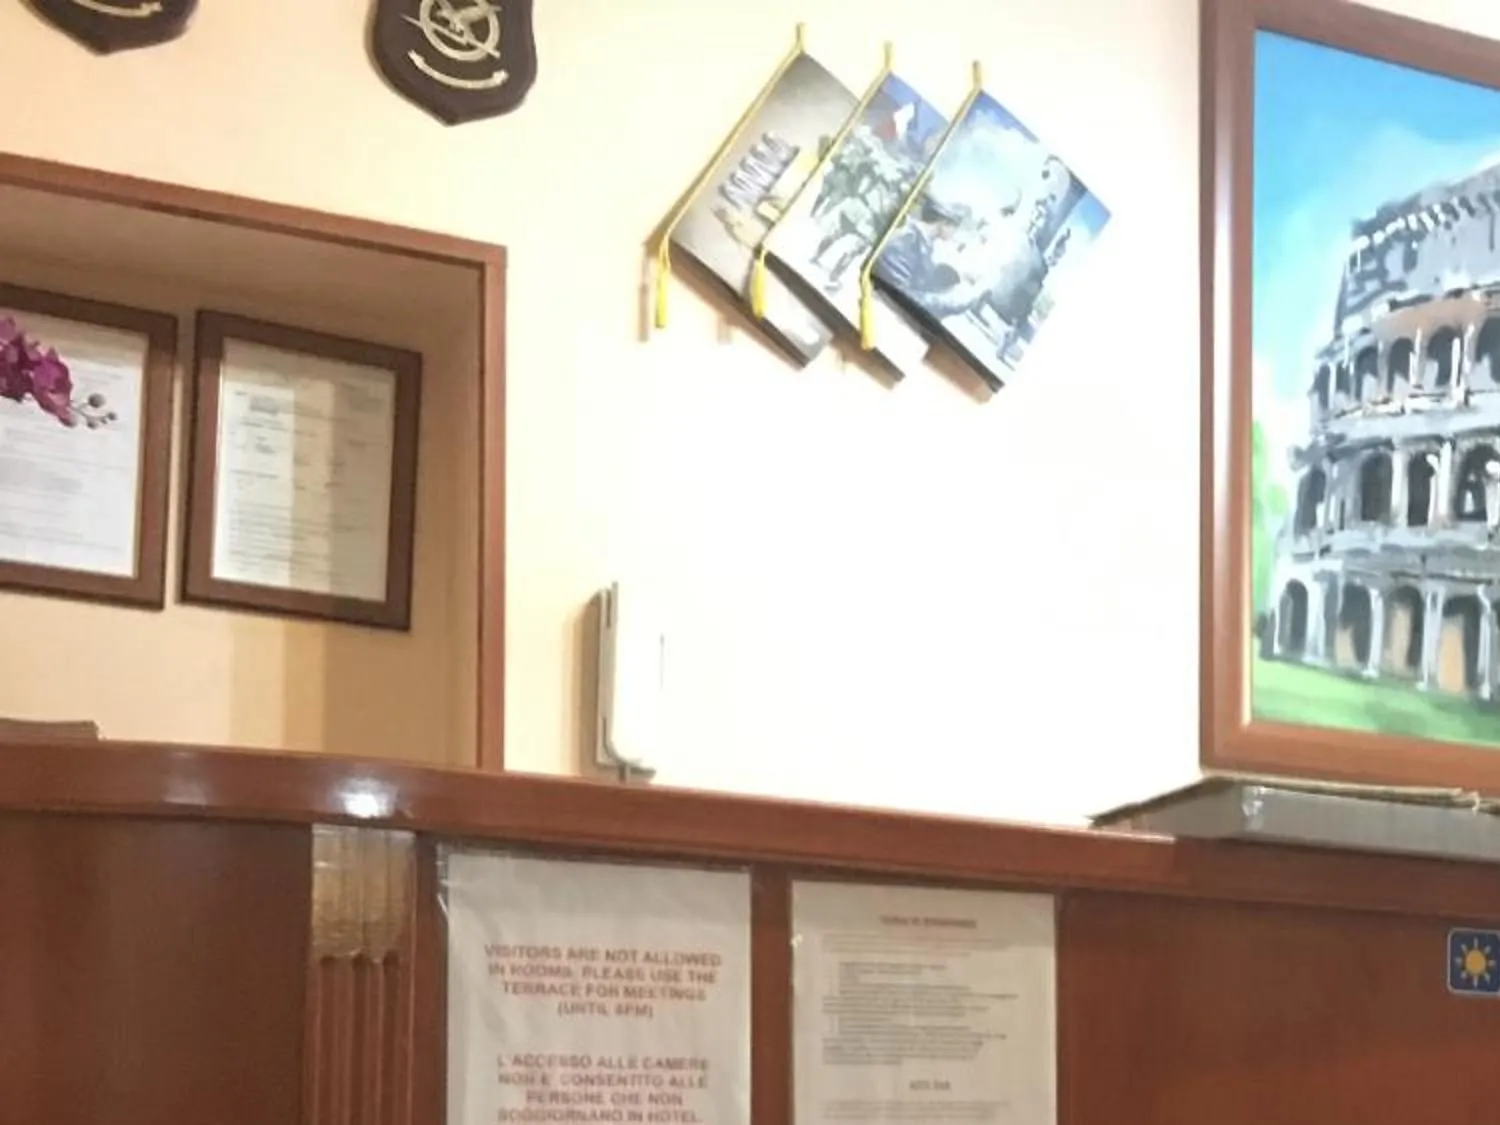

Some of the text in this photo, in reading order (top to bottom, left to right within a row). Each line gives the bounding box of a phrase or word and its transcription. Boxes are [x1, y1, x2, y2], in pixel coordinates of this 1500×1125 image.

[484, 943, 722, 967] VISITORS ARE NOT ALLOWED
[488, 963, 505, 977] IN
[582, 965, 645, 981] PLEASE
[650, 969, 681, 983] USE
[688, 970, 718, 984] THE
[503, 981, 707, 1001] TERRACE FOR MEETINGS
[597, 1054, 638, 1070] ALLE
[642, 1056, 709, 1071] CAMERE
[498, 1072, 535, 1086] NON
[560, 1073, 664, 1088] CONSENTITO
[669, 1075, 708, 1089] ALLE
[526, 1090, 683, 1106] PERSONE CHE NON
[498, 1108, 623, 1122] SOGGIORNANO
[628, 1109, 643, 1122] IN
